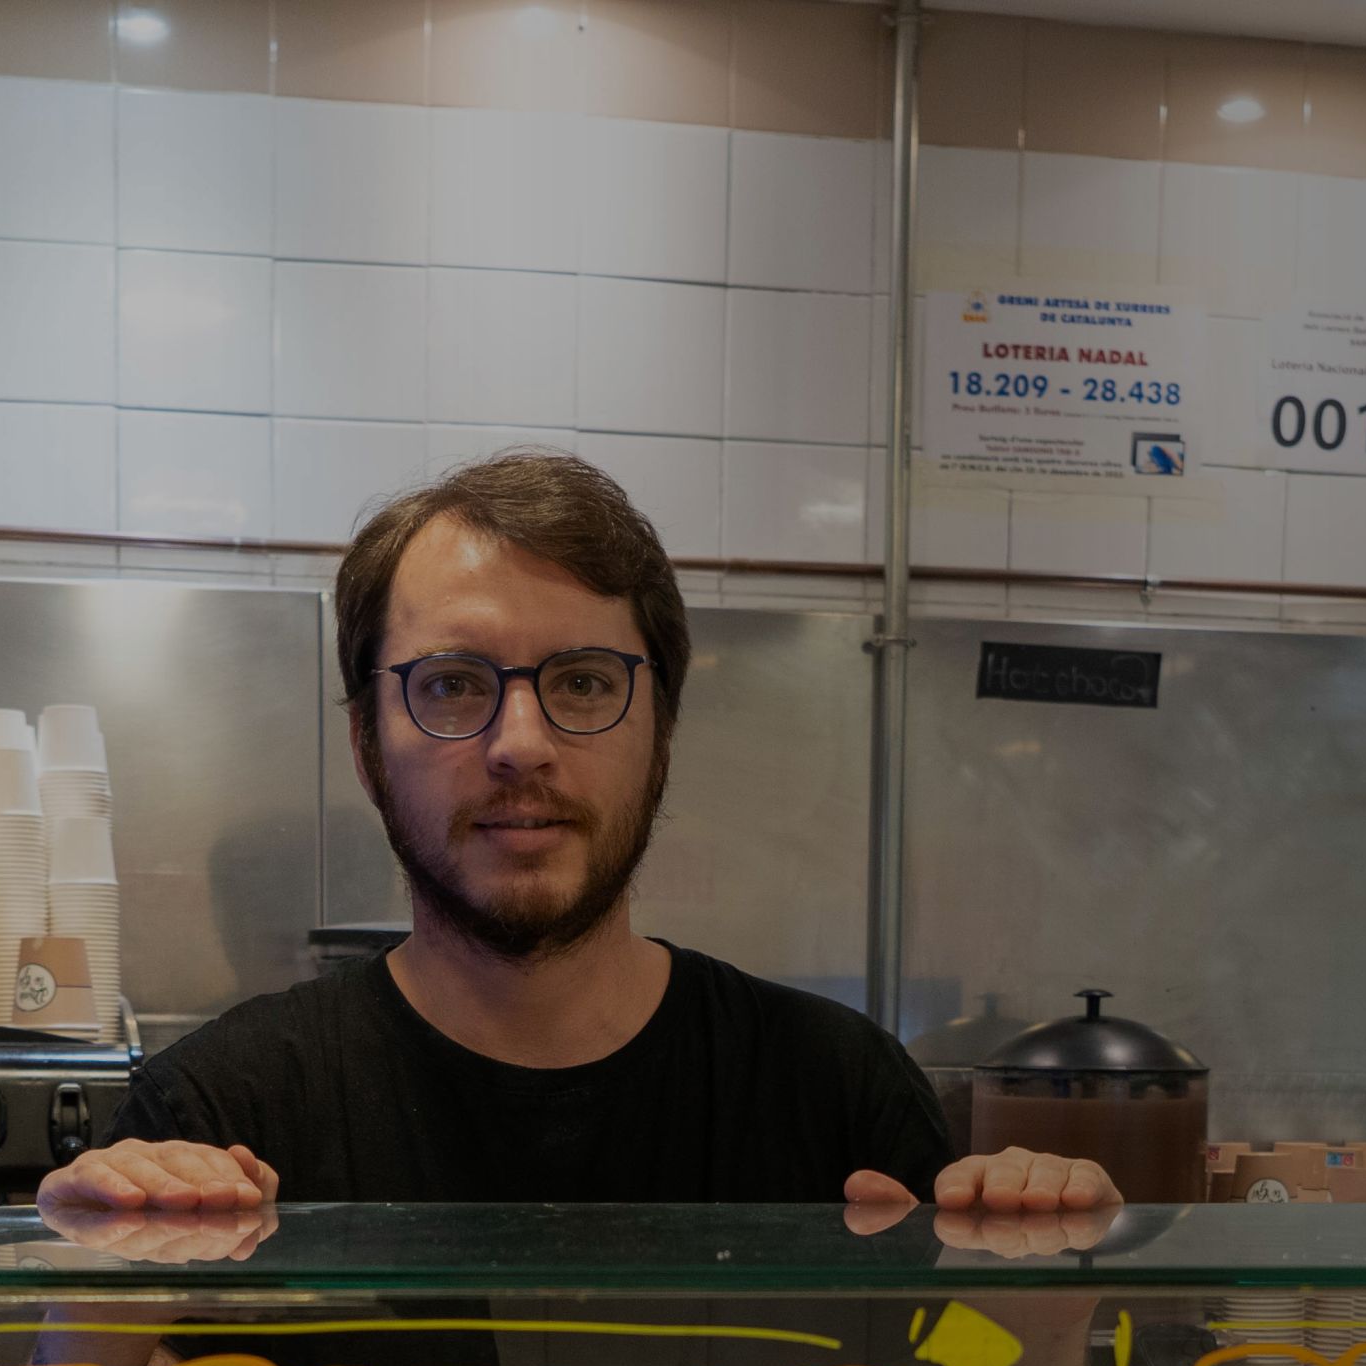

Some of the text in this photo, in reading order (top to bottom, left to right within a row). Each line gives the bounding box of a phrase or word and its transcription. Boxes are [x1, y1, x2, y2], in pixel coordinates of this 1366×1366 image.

[1094, 300, 1110, 311] DE
[1040, 312, 1056, 323] DE
[982, 342, 1149, 367] LOTERIA NADAL
[948, 371, 1048, 399] 18.209
[1083, 378, 1181, 405] 28.438
